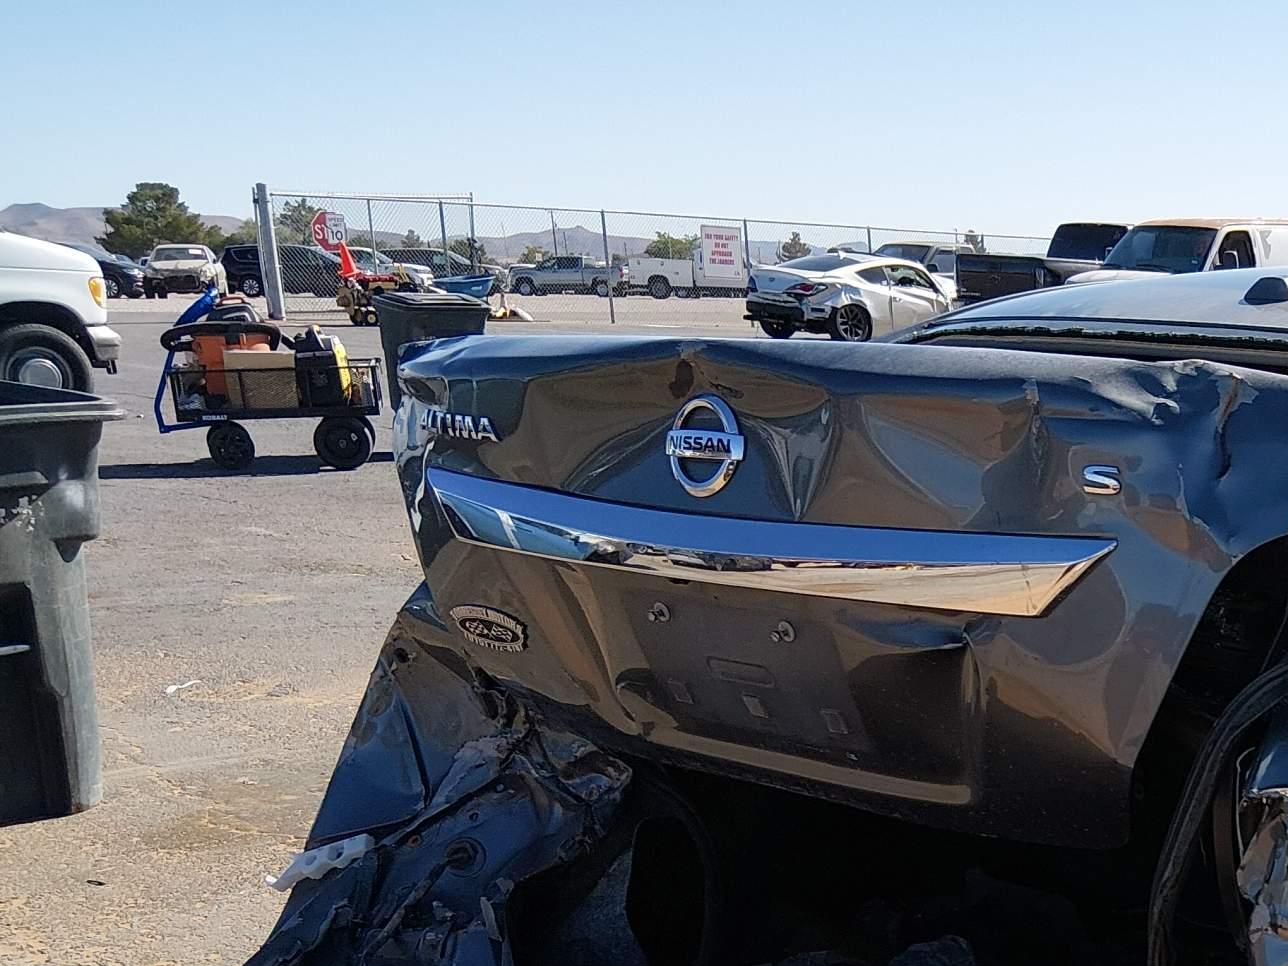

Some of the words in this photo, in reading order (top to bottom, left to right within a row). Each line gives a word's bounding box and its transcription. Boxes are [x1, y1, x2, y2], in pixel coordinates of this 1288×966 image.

[331, 230, 343, 241] 10
[420, 408, 500, 443] ALTIMA
[670, 435, 732, 454] NISSAN
[1083, 465, 1121, 495] S
